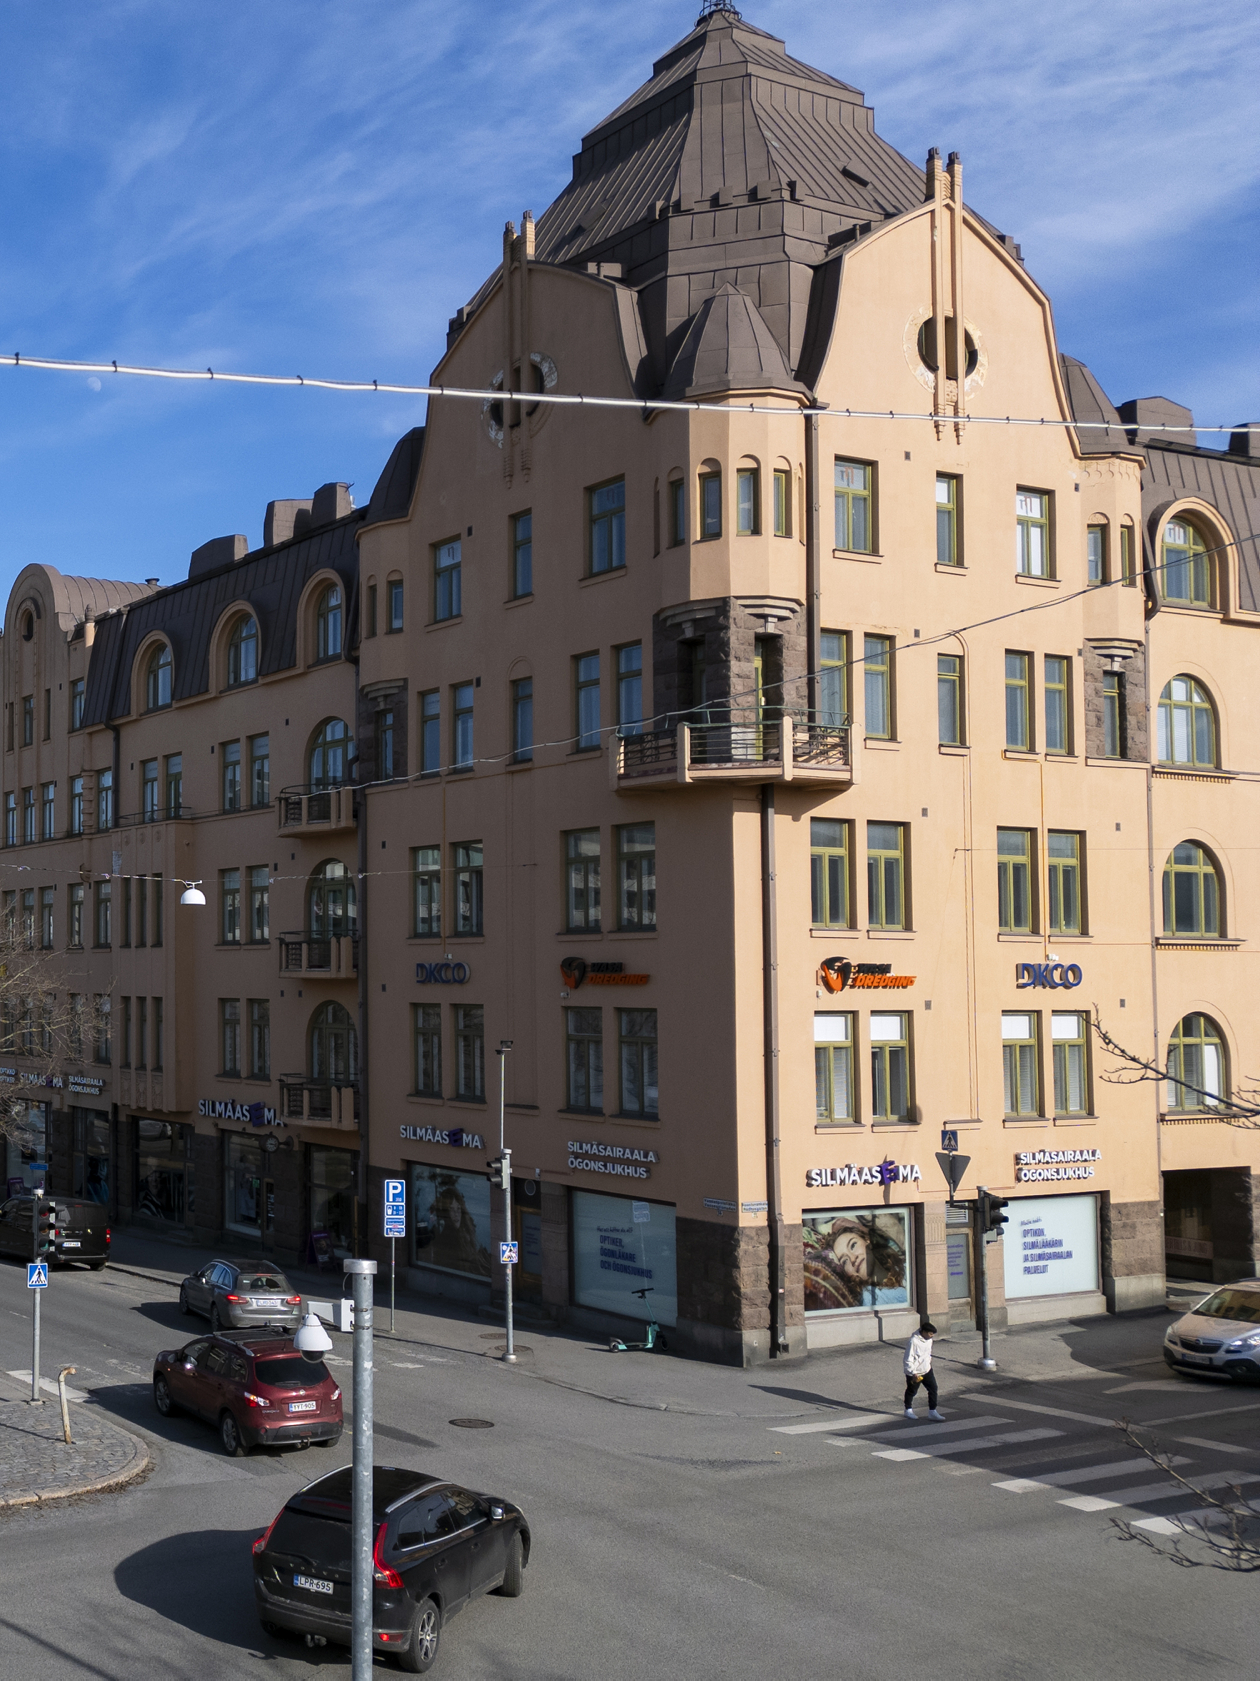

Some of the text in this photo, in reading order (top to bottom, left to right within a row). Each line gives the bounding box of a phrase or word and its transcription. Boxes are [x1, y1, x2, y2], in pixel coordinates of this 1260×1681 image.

[416, 962, 470, 984] DKCO
[588, 973, 649, 985] DREDGING
[854, 975, 918, 988] DREDGING
[1018, 962, 1083, 988] DKCO
[399, 1124, 483, 1149] SILMÄASEMA
[567, 1140, 658, 1163] SILMÄSAIRAALA
[1019, 1149, 1103, 1164] SILMÄSAIRAALA
[567, 1154, 648, 1179] ÖGONSJUKHUS
[809, 1160, 923, 1186] SILMÄASEMA
[1020, 1166, 1096, 1182] ÖGONSJUKHUS
[389, 1182, 402, 1202] P
[599, 1246, 637, 1263] ÖGONLÄKARE
[600, 1259, 612, 1271] OCH
[299, 1576, 332, 1592] LPR-695
